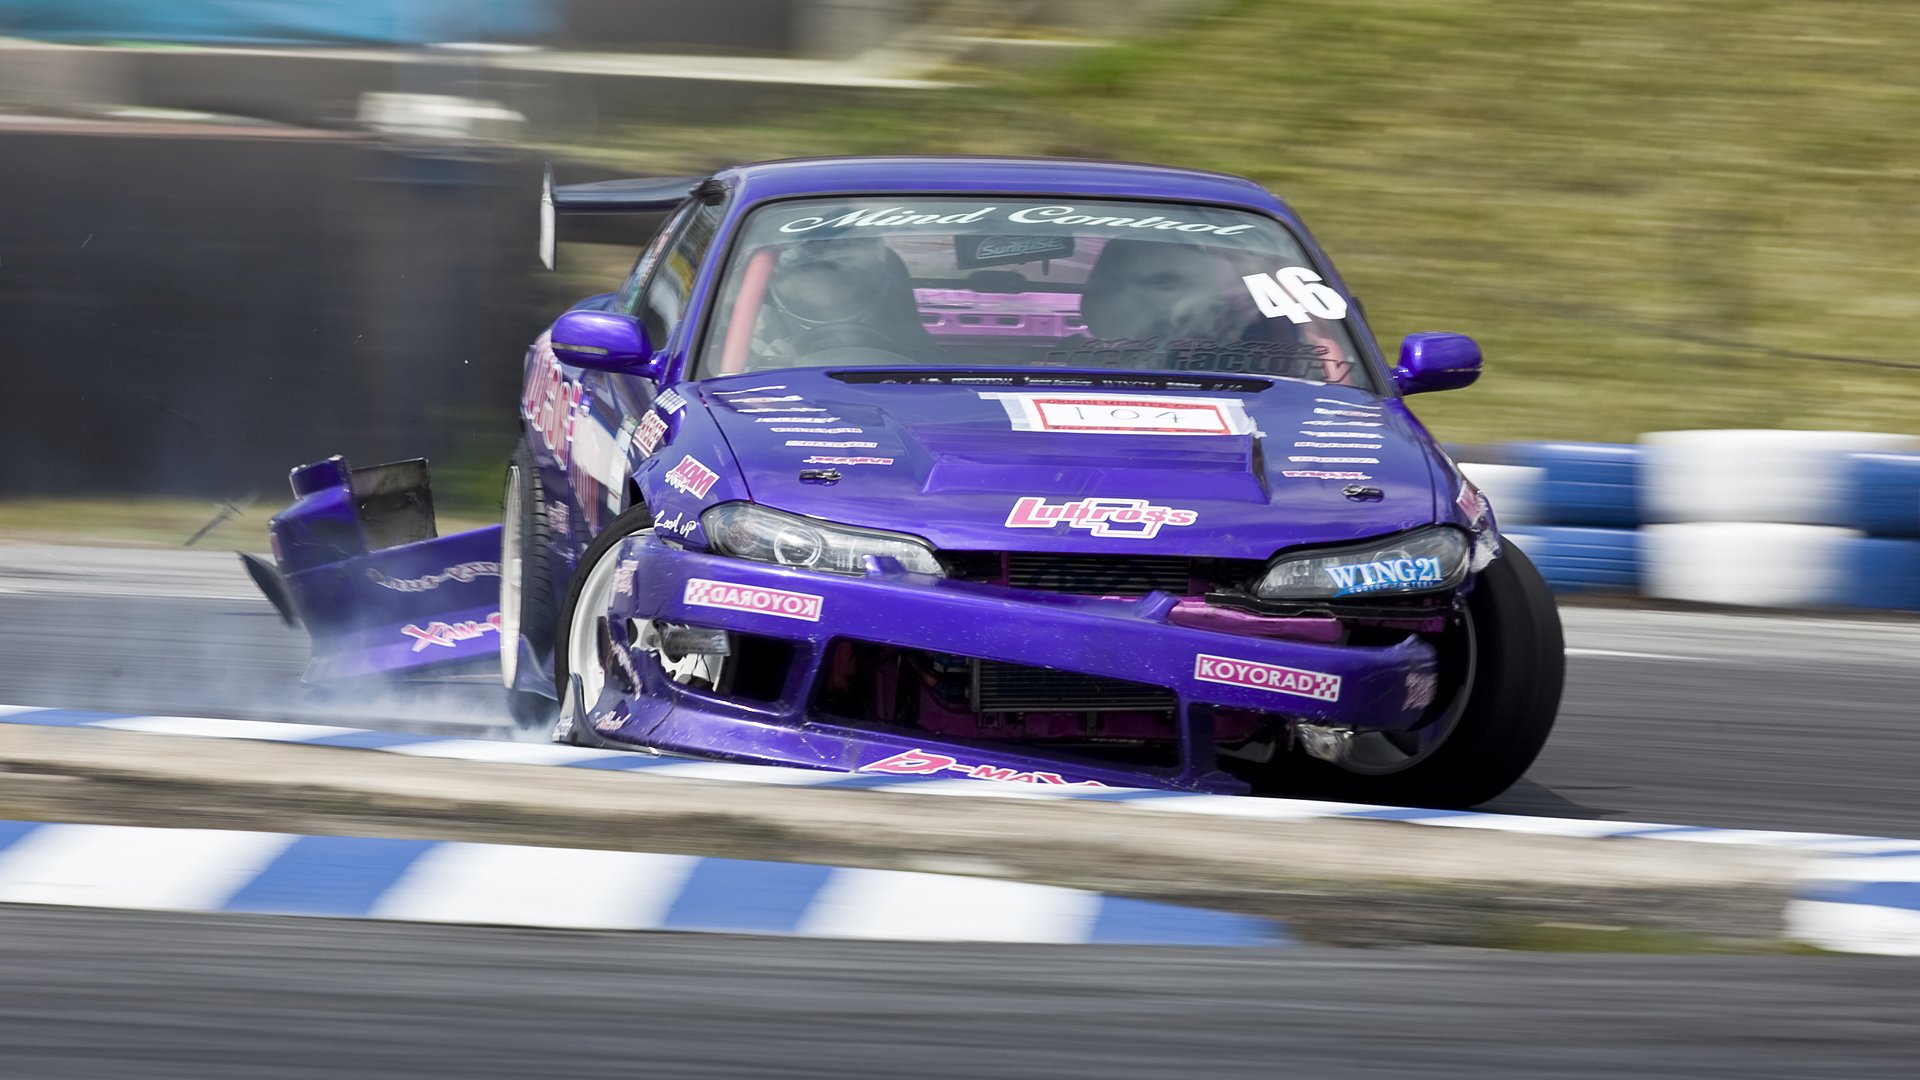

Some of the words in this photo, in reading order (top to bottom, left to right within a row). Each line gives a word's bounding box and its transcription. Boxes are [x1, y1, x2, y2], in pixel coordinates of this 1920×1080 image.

[779, 207, 996, 233] Mind
[1008, 206, 1255, 236] Control
[1241, 266, 1347, 324] 46
[1325, 557, 1443, 588] WING21
[1200, 659, 1314, 691] KOYORAD
